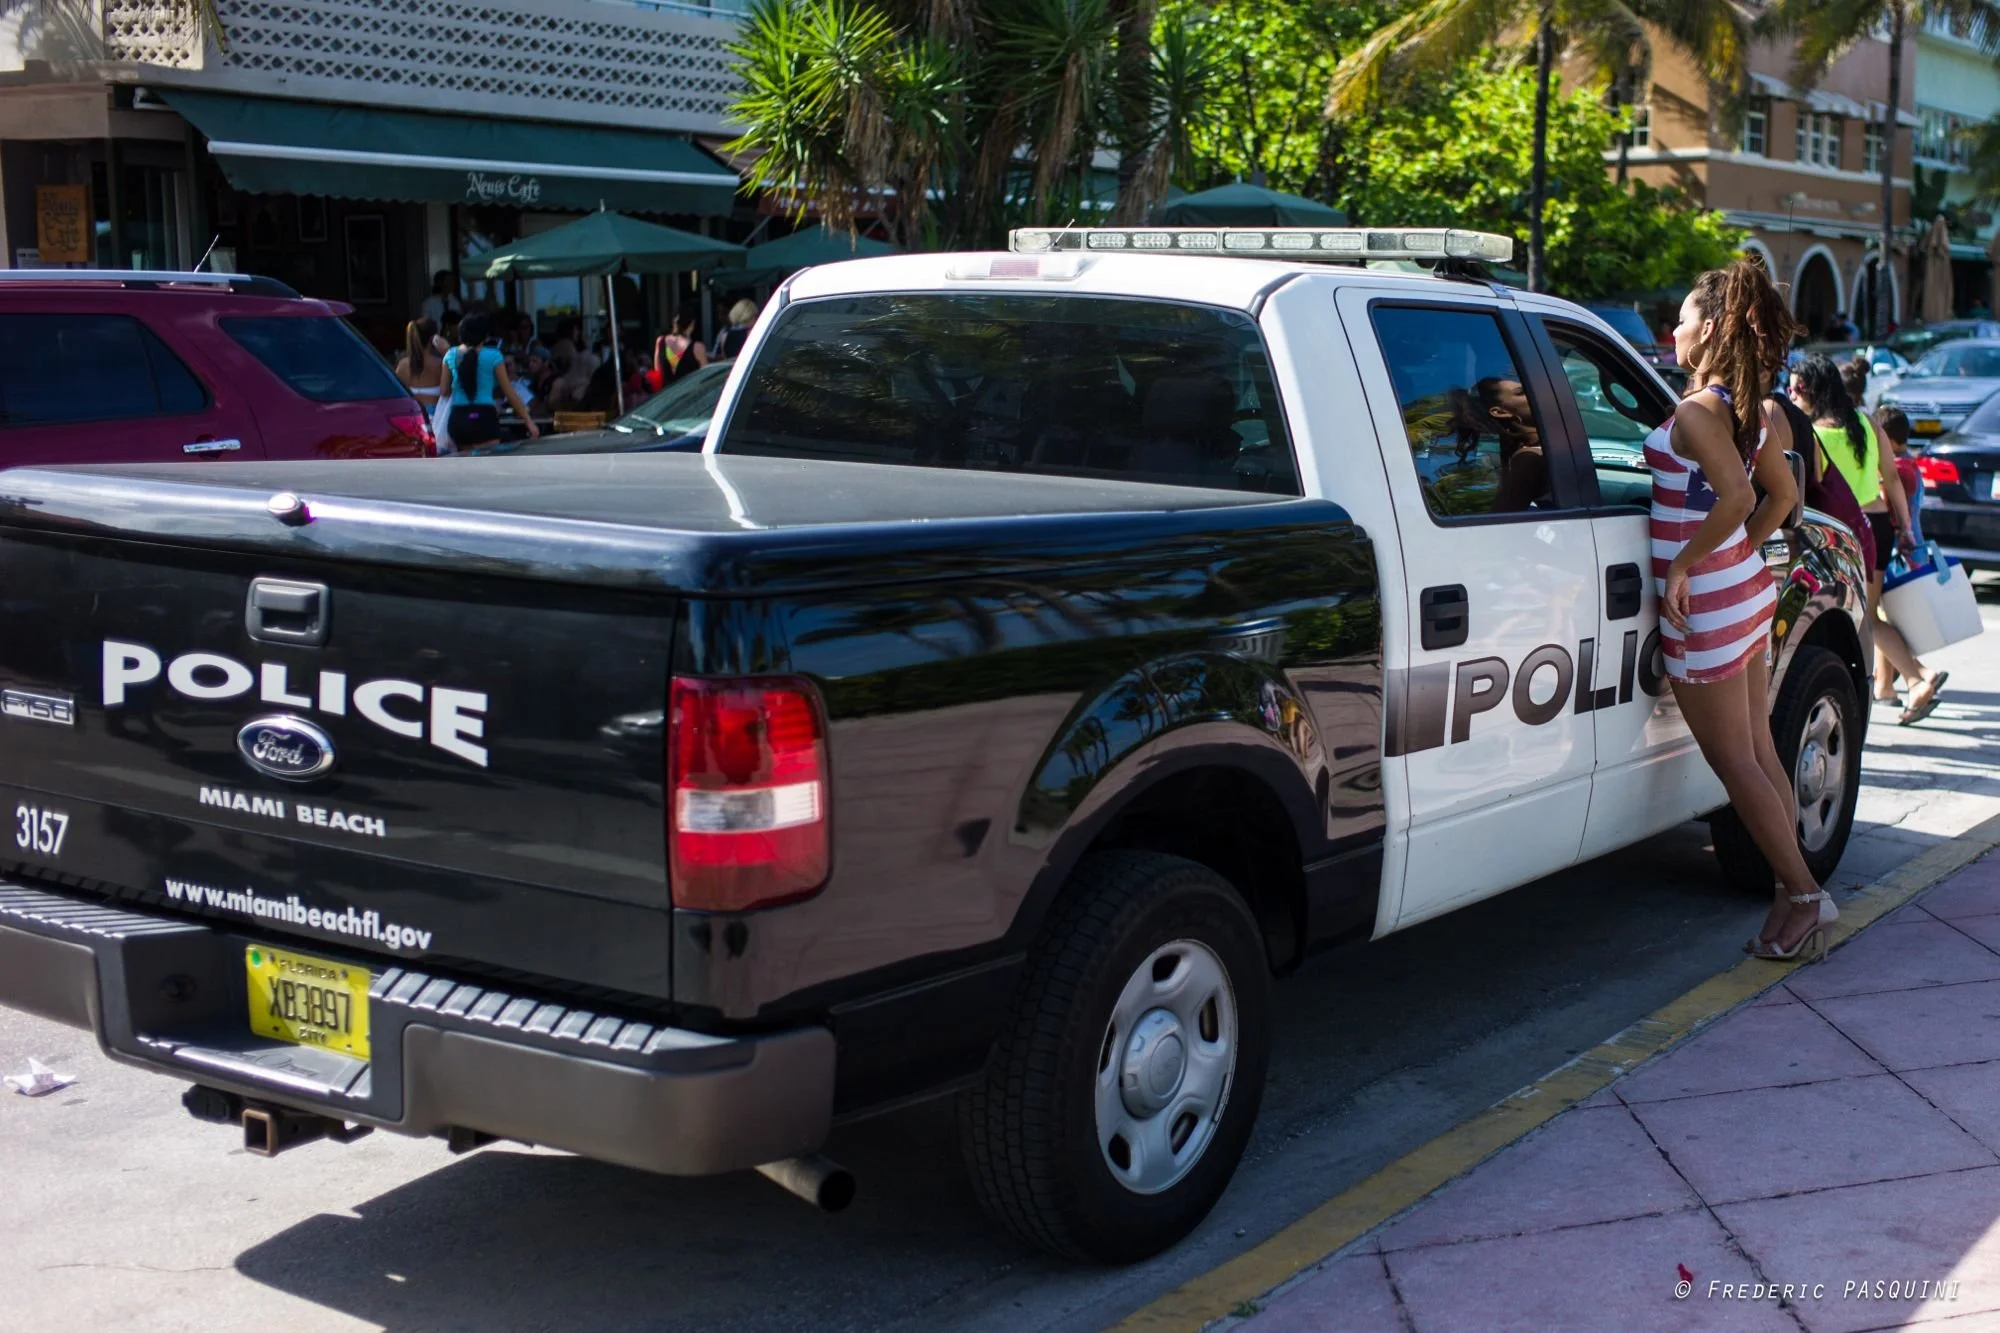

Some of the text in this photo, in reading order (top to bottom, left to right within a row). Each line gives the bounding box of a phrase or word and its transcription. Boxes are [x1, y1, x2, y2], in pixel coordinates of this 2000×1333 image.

[466, 172, 506, 199] News
[103, 640, 488, 767] POLICE
[1451, 626, 1669, 745] POLIC
[253, 729, 304, 765] Ford
[16, 805, 69, 855] 3157
[200, 786, 386, 837] MIAMI BEACH
[165, 879, 432, 950] www.miamibeachfl.gov
[280, 959, 337, 980] FLORIDA
[268, 976, 350, 1034] XB3897
